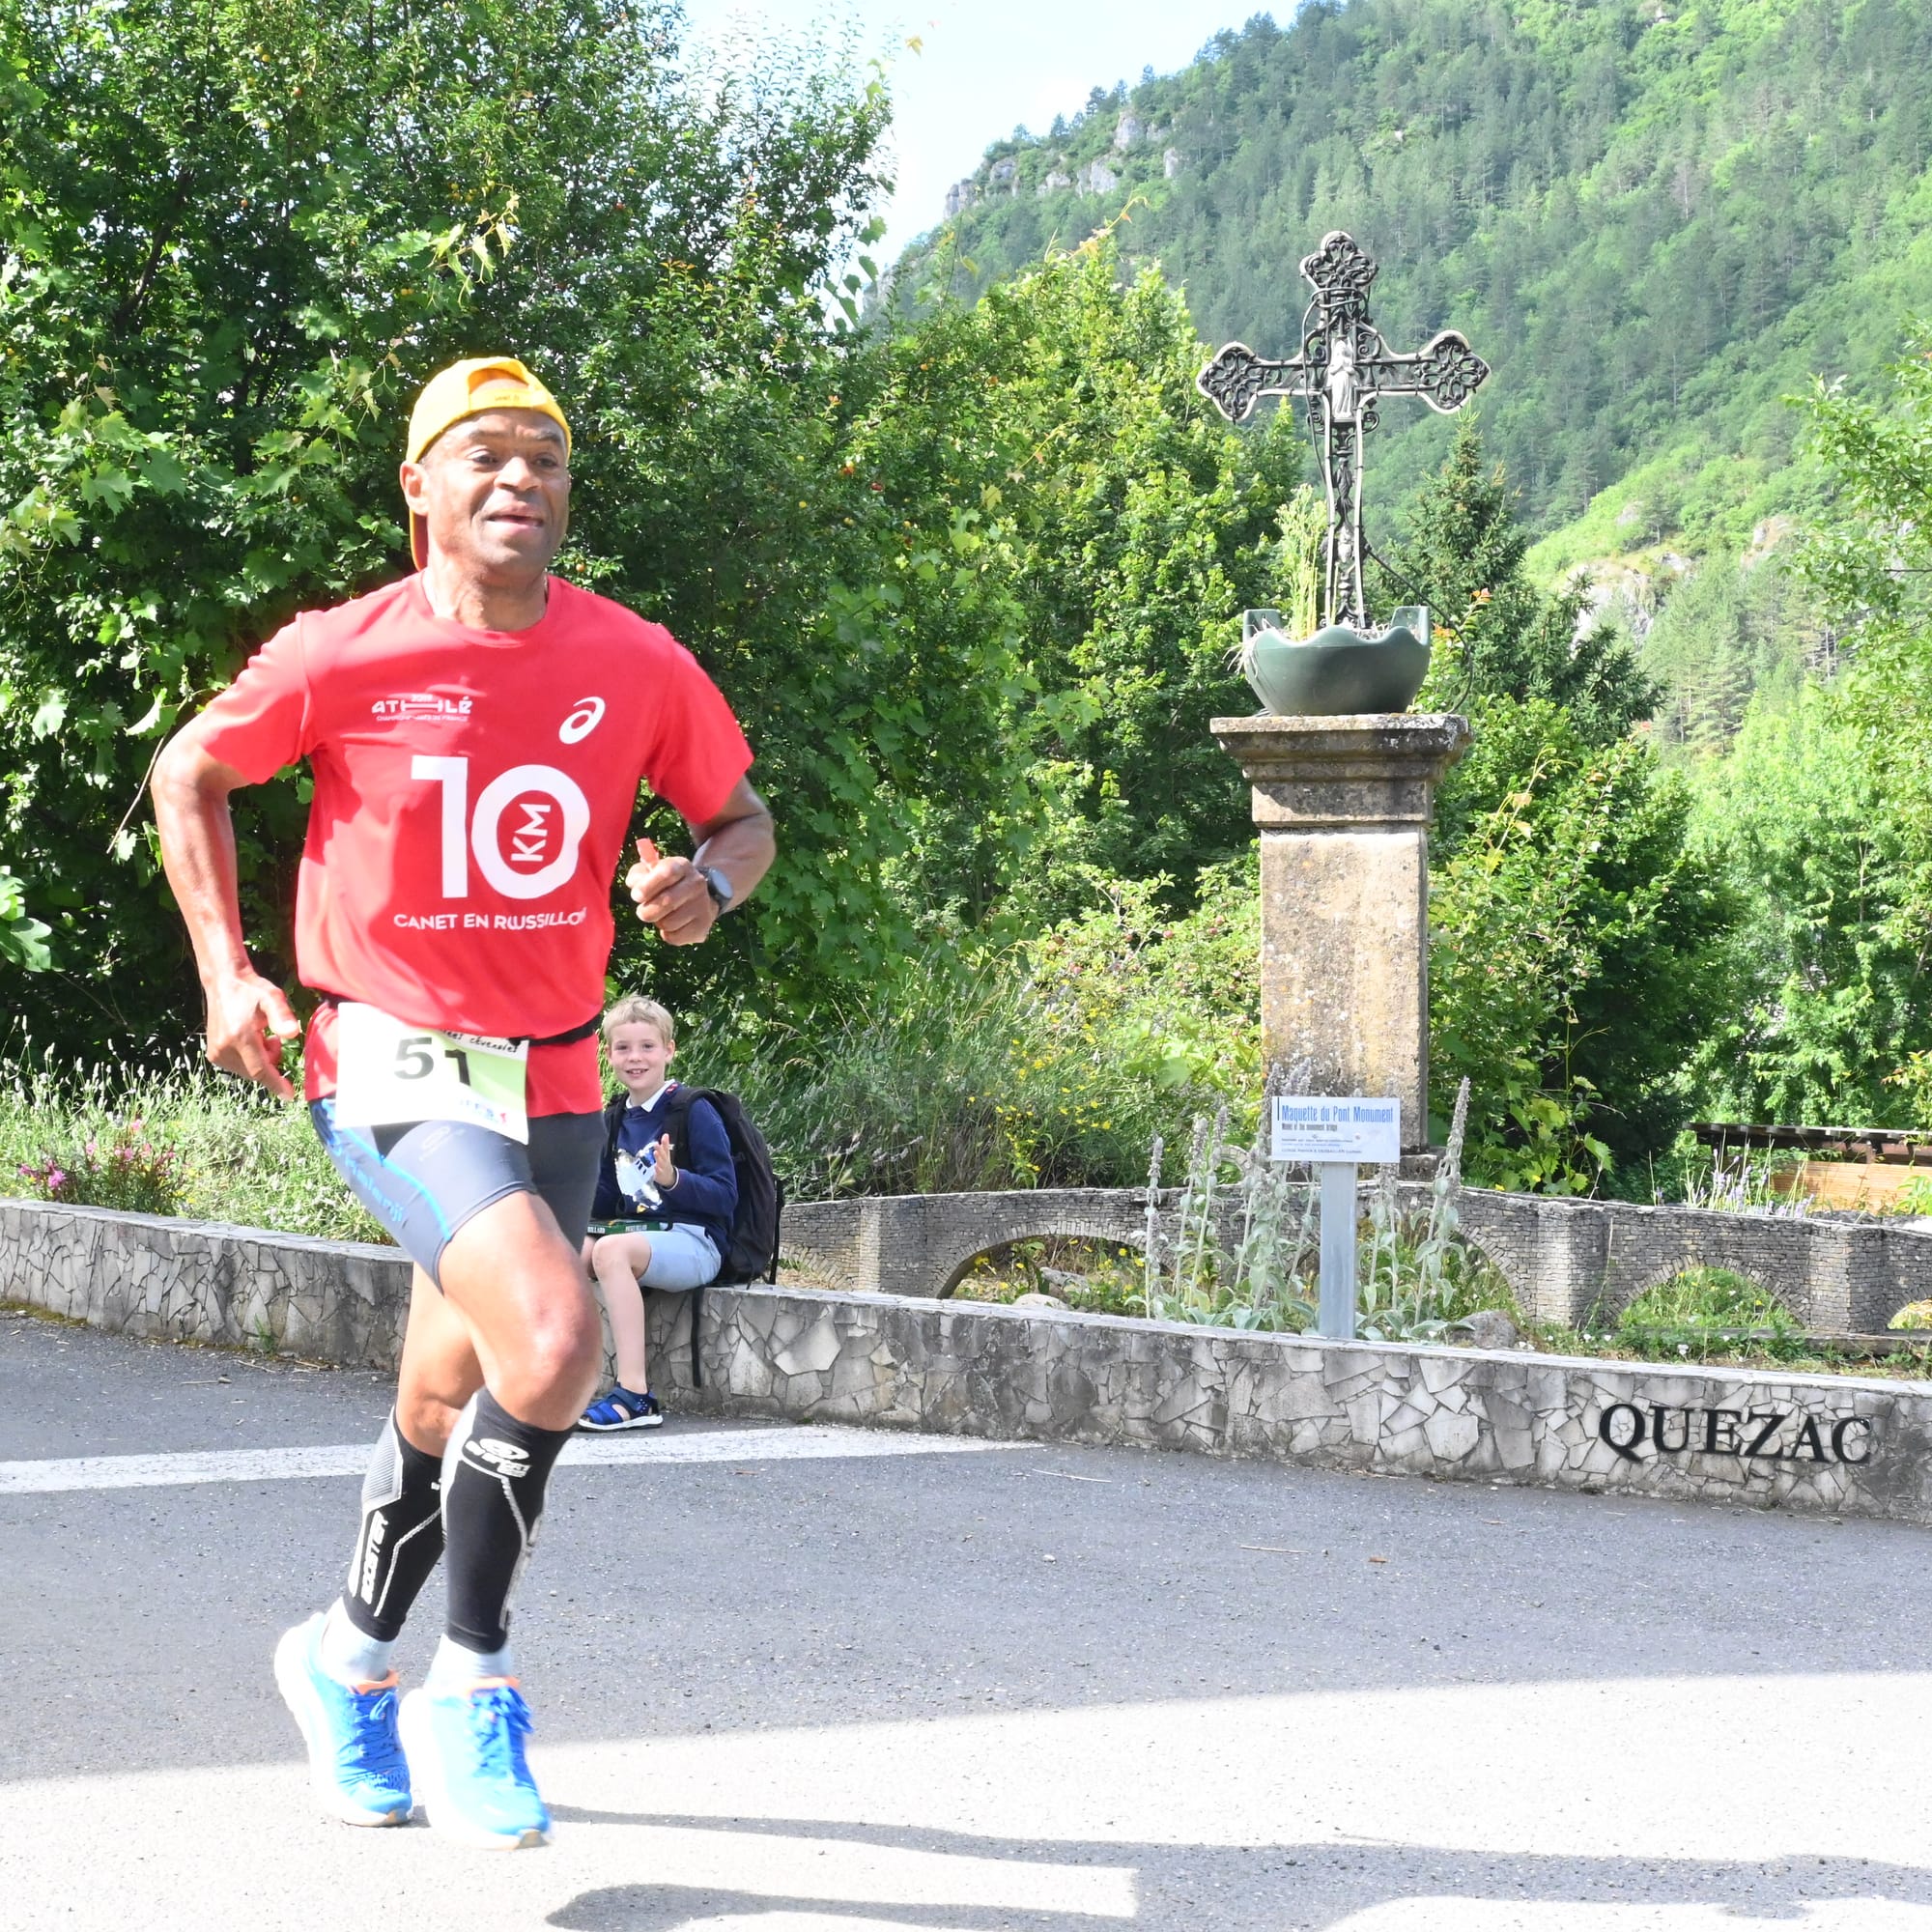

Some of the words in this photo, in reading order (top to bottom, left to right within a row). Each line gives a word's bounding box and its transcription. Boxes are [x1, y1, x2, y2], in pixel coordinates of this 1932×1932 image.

[371, 695, 473, 715] ATHLÉ
[411, 754, 590, 899] 10
[511, 803, 552, 862] KM
[393, 914, 458, 929] CANET
[463, 914, 490, 928] EN
[393, 1037, 471, 1087] 51
[1281, 1105, 1318, 1122] Maquette
[1321, 1106, 1330, 1122] du
[1333, 1106, 1350, 1122] Pont
[1353, 1106, 1394, 1122] Monument
[1599, 1403, 1872, 1464] QUEZAC
